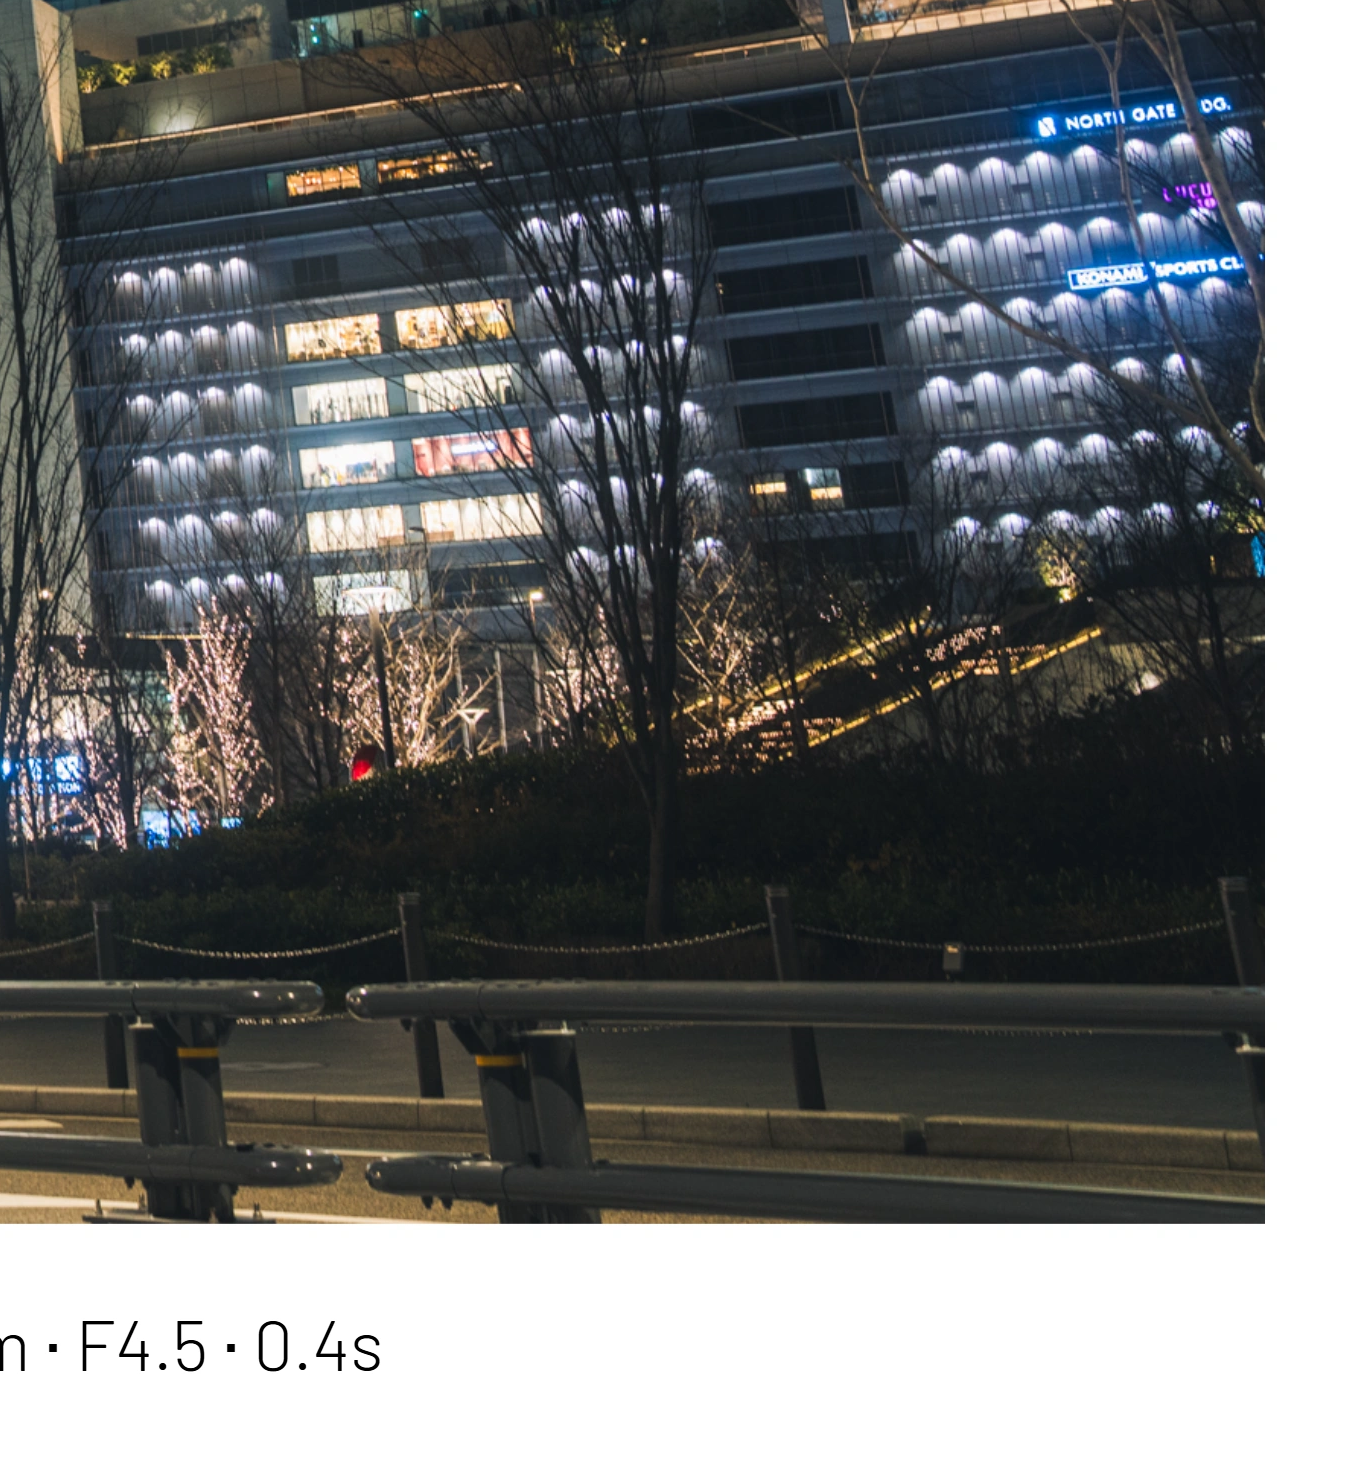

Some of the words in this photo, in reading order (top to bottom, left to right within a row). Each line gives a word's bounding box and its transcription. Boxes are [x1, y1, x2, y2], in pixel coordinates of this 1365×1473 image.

[1065, 109, 1126, 130] NORTH
[1132, 103, 1176, 122] GATE
[1075, 266, 1145, 286] KONAMI
[1155, 258, 1218, 278] SPORTS
